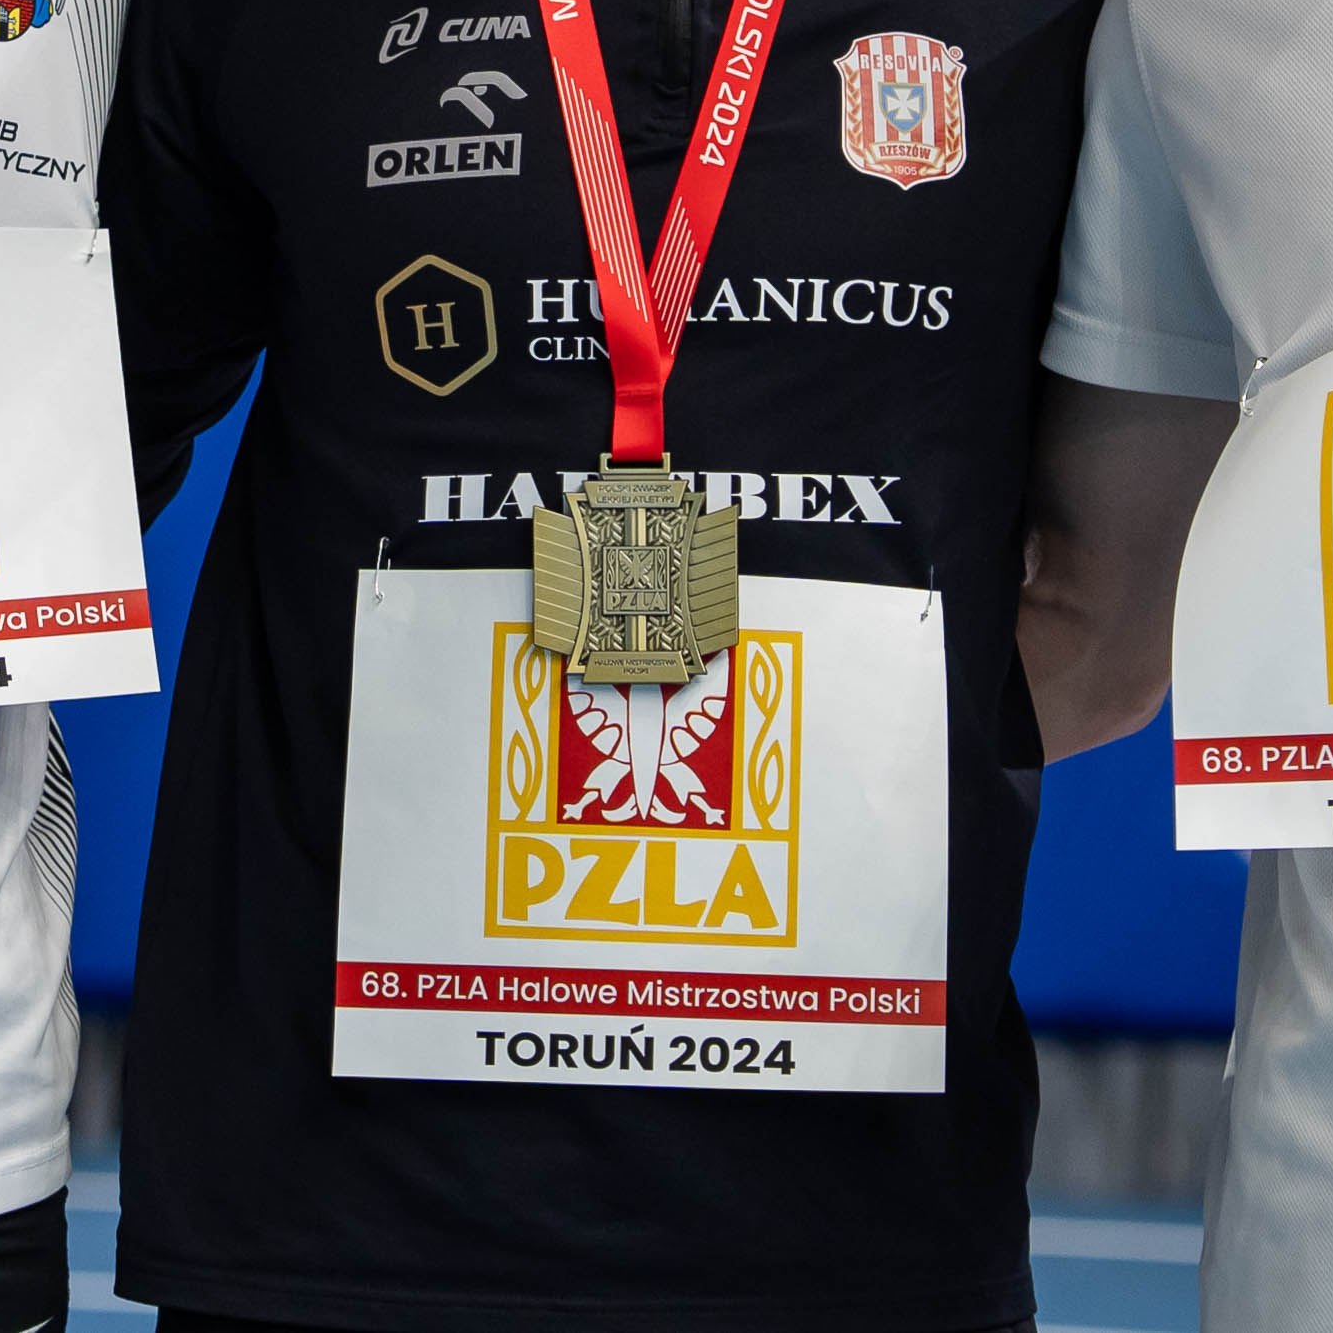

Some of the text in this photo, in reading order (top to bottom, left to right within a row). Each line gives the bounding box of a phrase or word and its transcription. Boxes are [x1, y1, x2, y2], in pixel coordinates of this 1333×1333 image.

[439, 15, 531, 43] CUNA
[859, 54, 943, 72] RESOVIA
[699, 81, 747, 167] 2024
[374, 139, 515, 178] ORLEN
[878, 144, 932, 160] RZESZÓW
[527, 277, 954, 331] HANICUS
[406, 301, 460, 352] H
[528, 336, 612, 362] CLIN
[418, 470, 902, 525] HABEX
[36, 597, 127, 629] Polski
[606, 592, 667, 611] PZLA
[1202, 747, 1252, 774] 68.
[501, 835, 780, 930] PZLA
[361, 971, 921, 1014] 68. PZLA Halowe Mistrzostwa Polski
[476, 1024, 796, 1075] TORUŃ 2024
